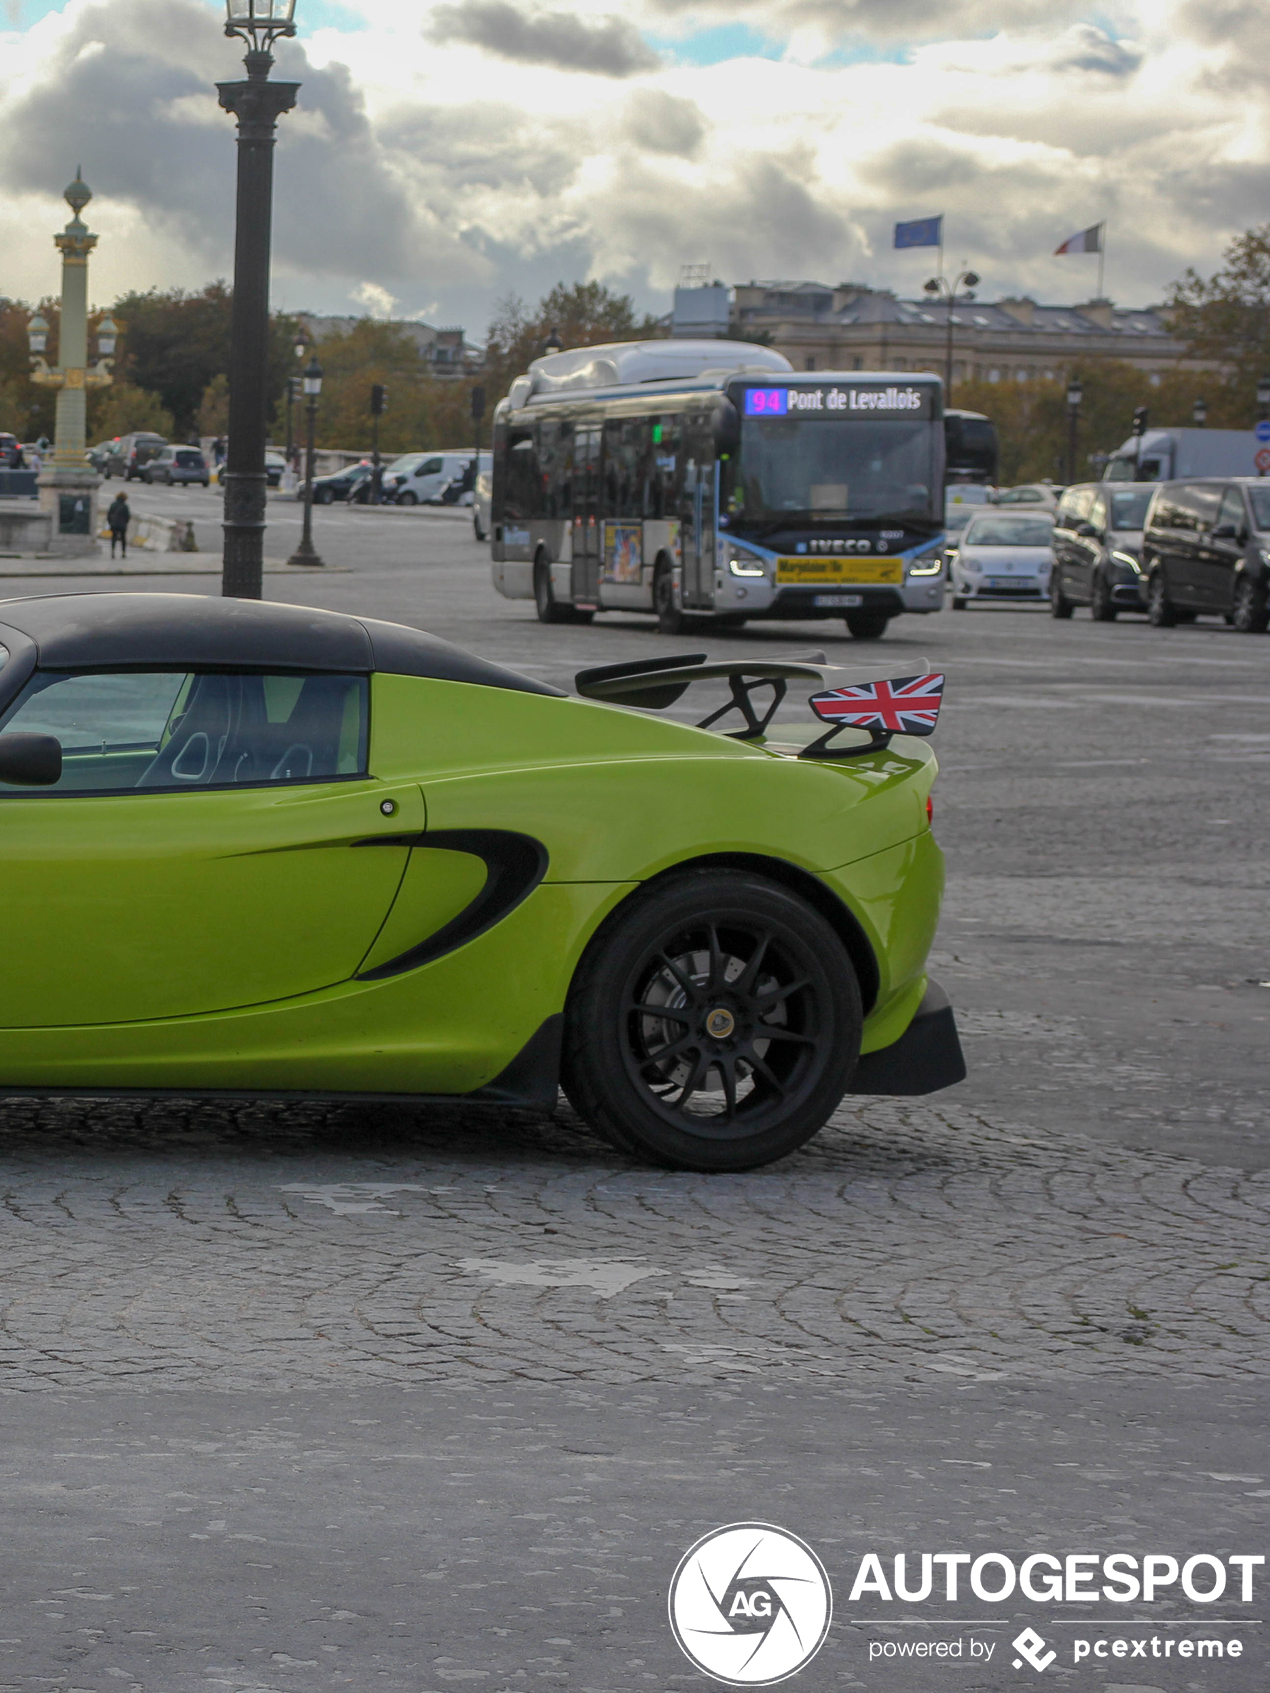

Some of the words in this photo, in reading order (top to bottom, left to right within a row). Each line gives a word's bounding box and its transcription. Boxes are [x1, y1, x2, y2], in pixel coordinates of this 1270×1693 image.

[752, 391, 781, 412] 94
[787, 389, 824, 410] Pont
[826, 388, 847, 410] de
[849, 387, 922, 410] Levallois
[810, 540, 871, 553] IVECO
